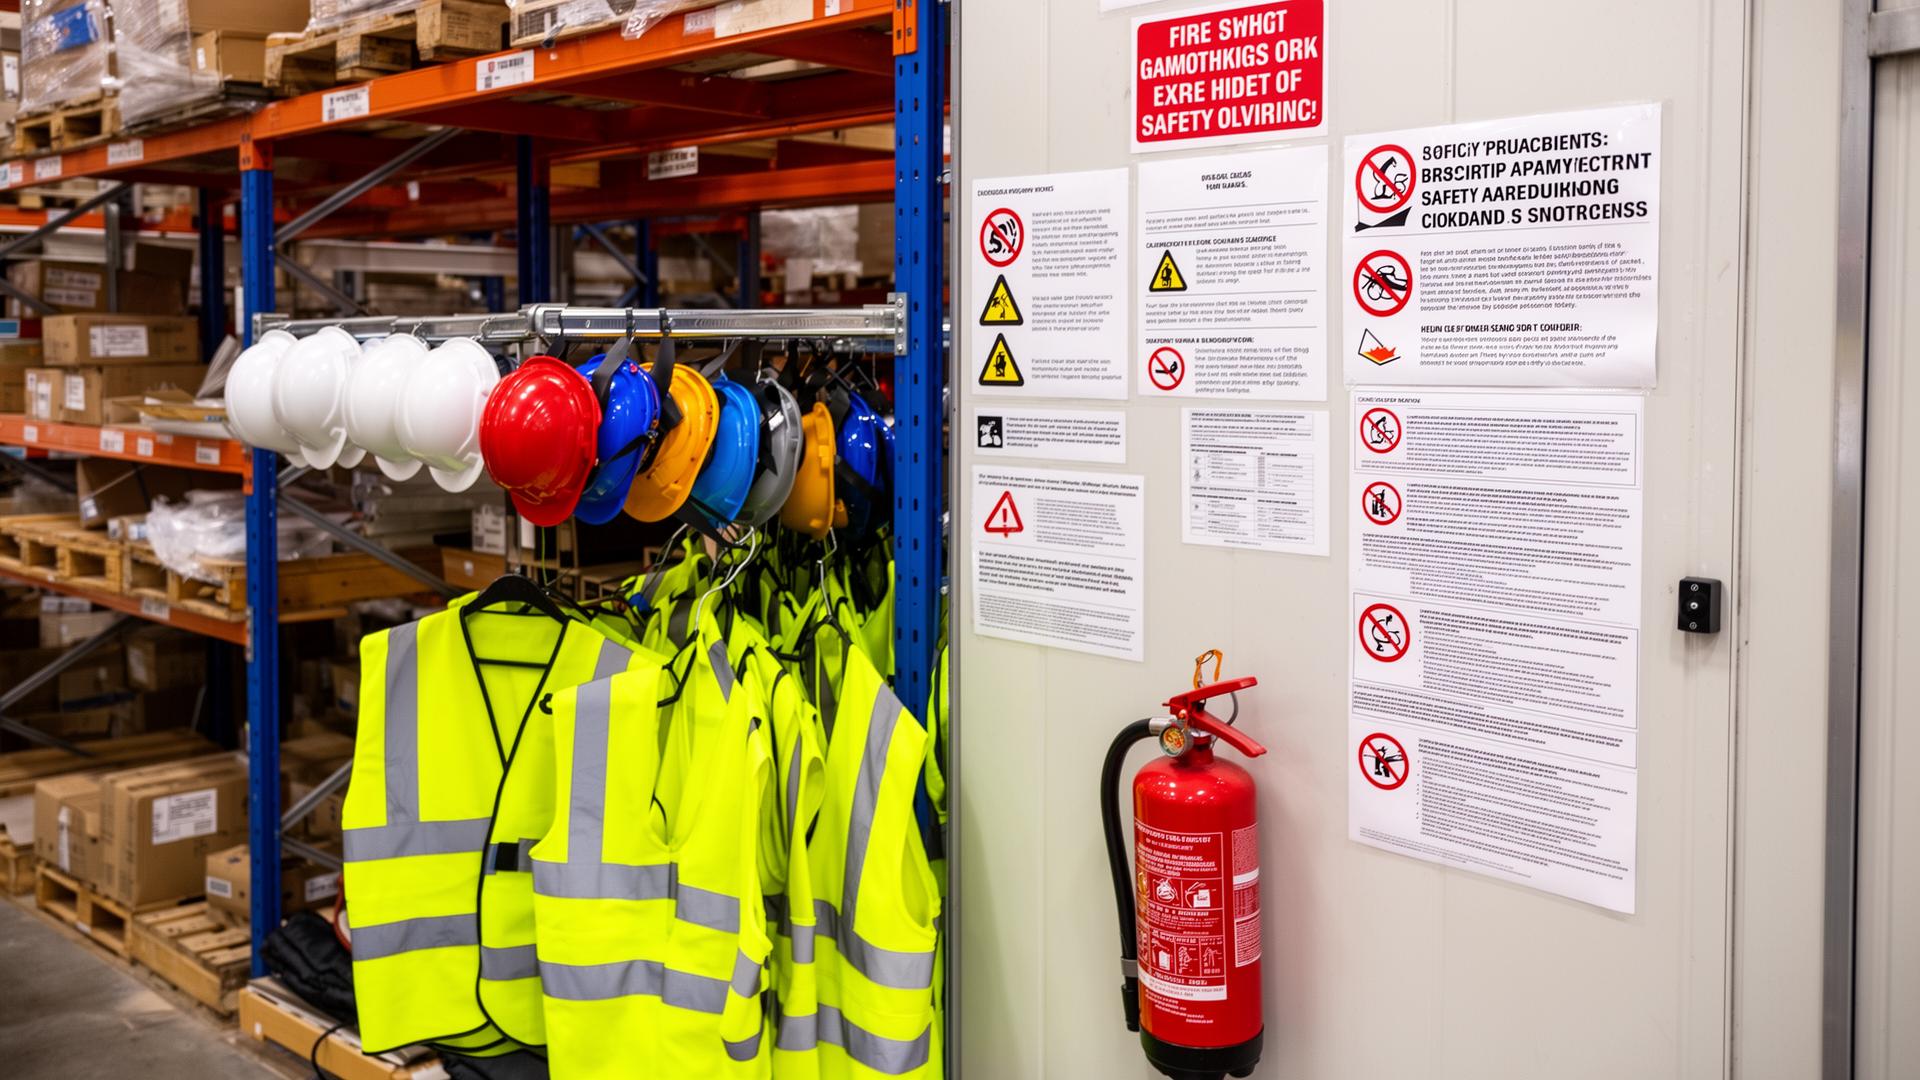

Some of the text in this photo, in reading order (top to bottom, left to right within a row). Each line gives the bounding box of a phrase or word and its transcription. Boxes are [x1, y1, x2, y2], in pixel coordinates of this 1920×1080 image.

[1169, 21, 1211, 48] FIRE
[1275, 36, 1318, 63] ORK
[1153, 69, 1302, 107] EXRE HIDET OF
[1141, 98, 1317, 136] SAFETY OLVIRINC!
[1422, 187, 1478, 206] SAFETY
